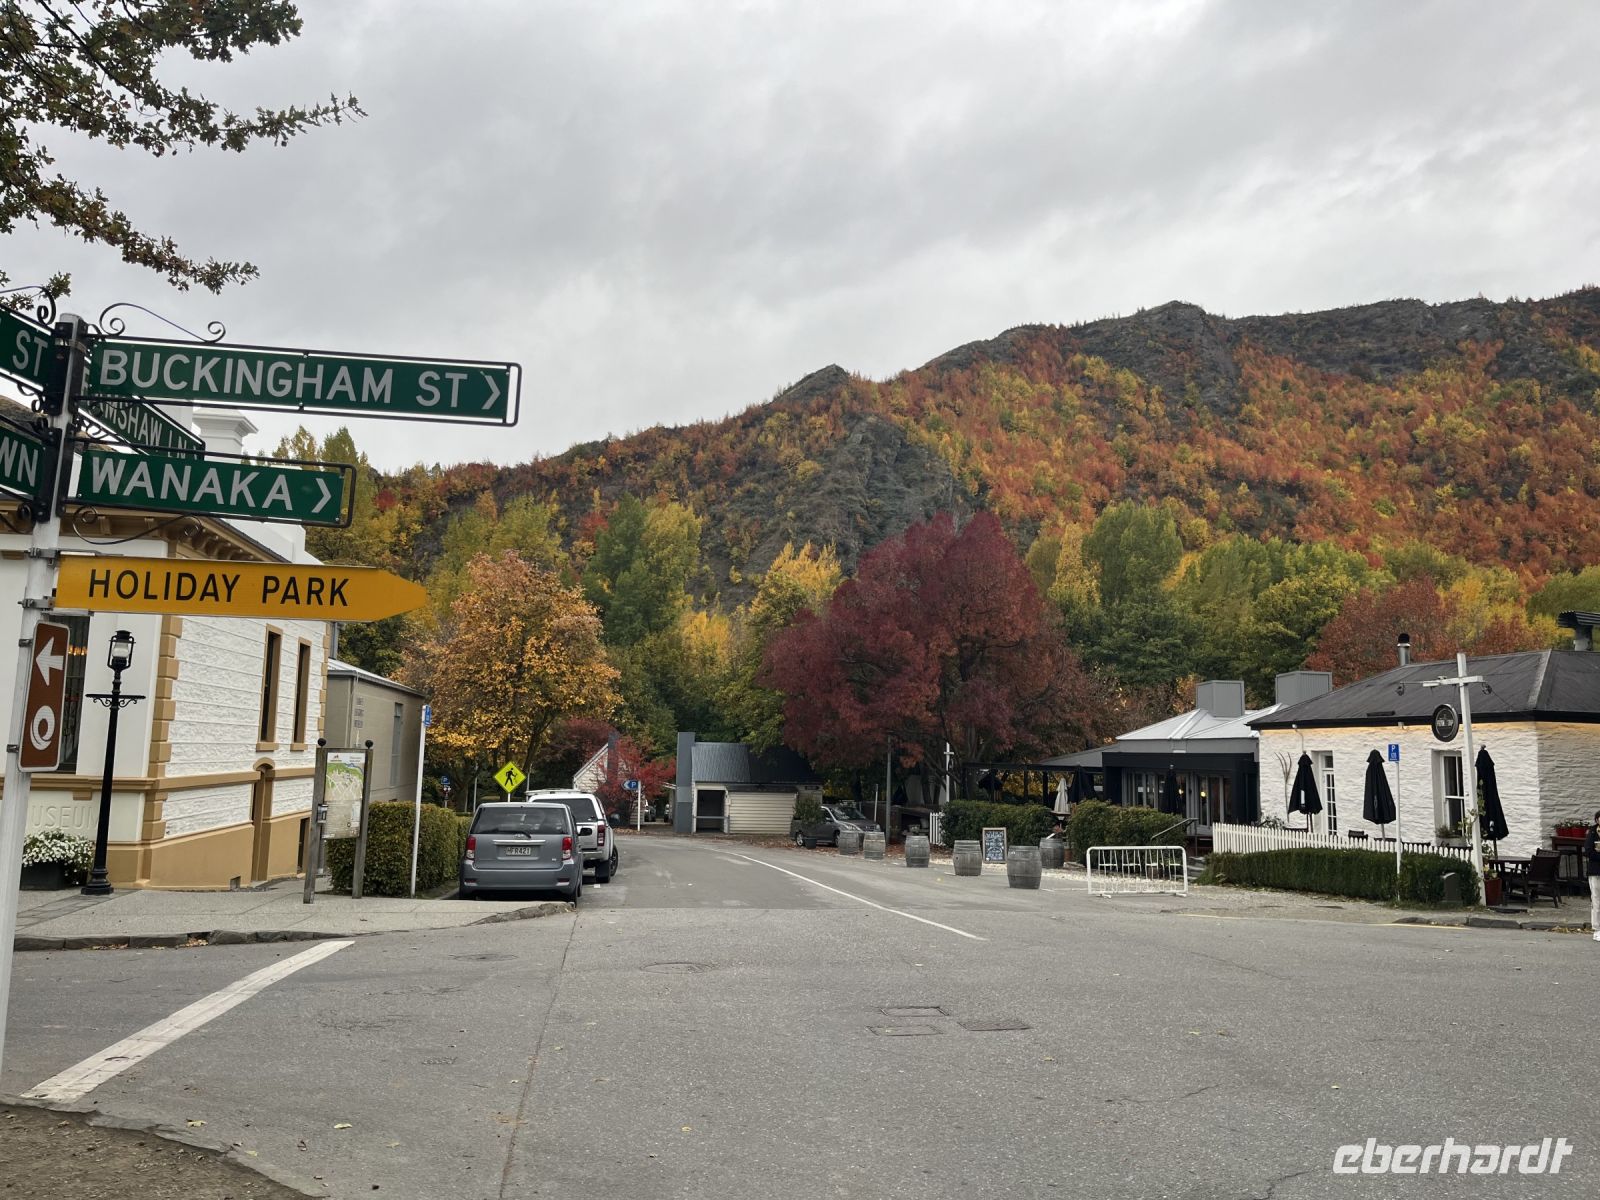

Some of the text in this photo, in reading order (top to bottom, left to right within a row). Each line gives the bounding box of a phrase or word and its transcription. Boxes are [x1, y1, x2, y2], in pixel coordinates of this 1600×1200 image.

[12, 329, 49, 377] ST
[100, 349, 468, 408] BUCKINGHAM ST
[92, 456, 293, 511] WANAKA
[88, 569, 350, 607] HOLIDAY PARK
